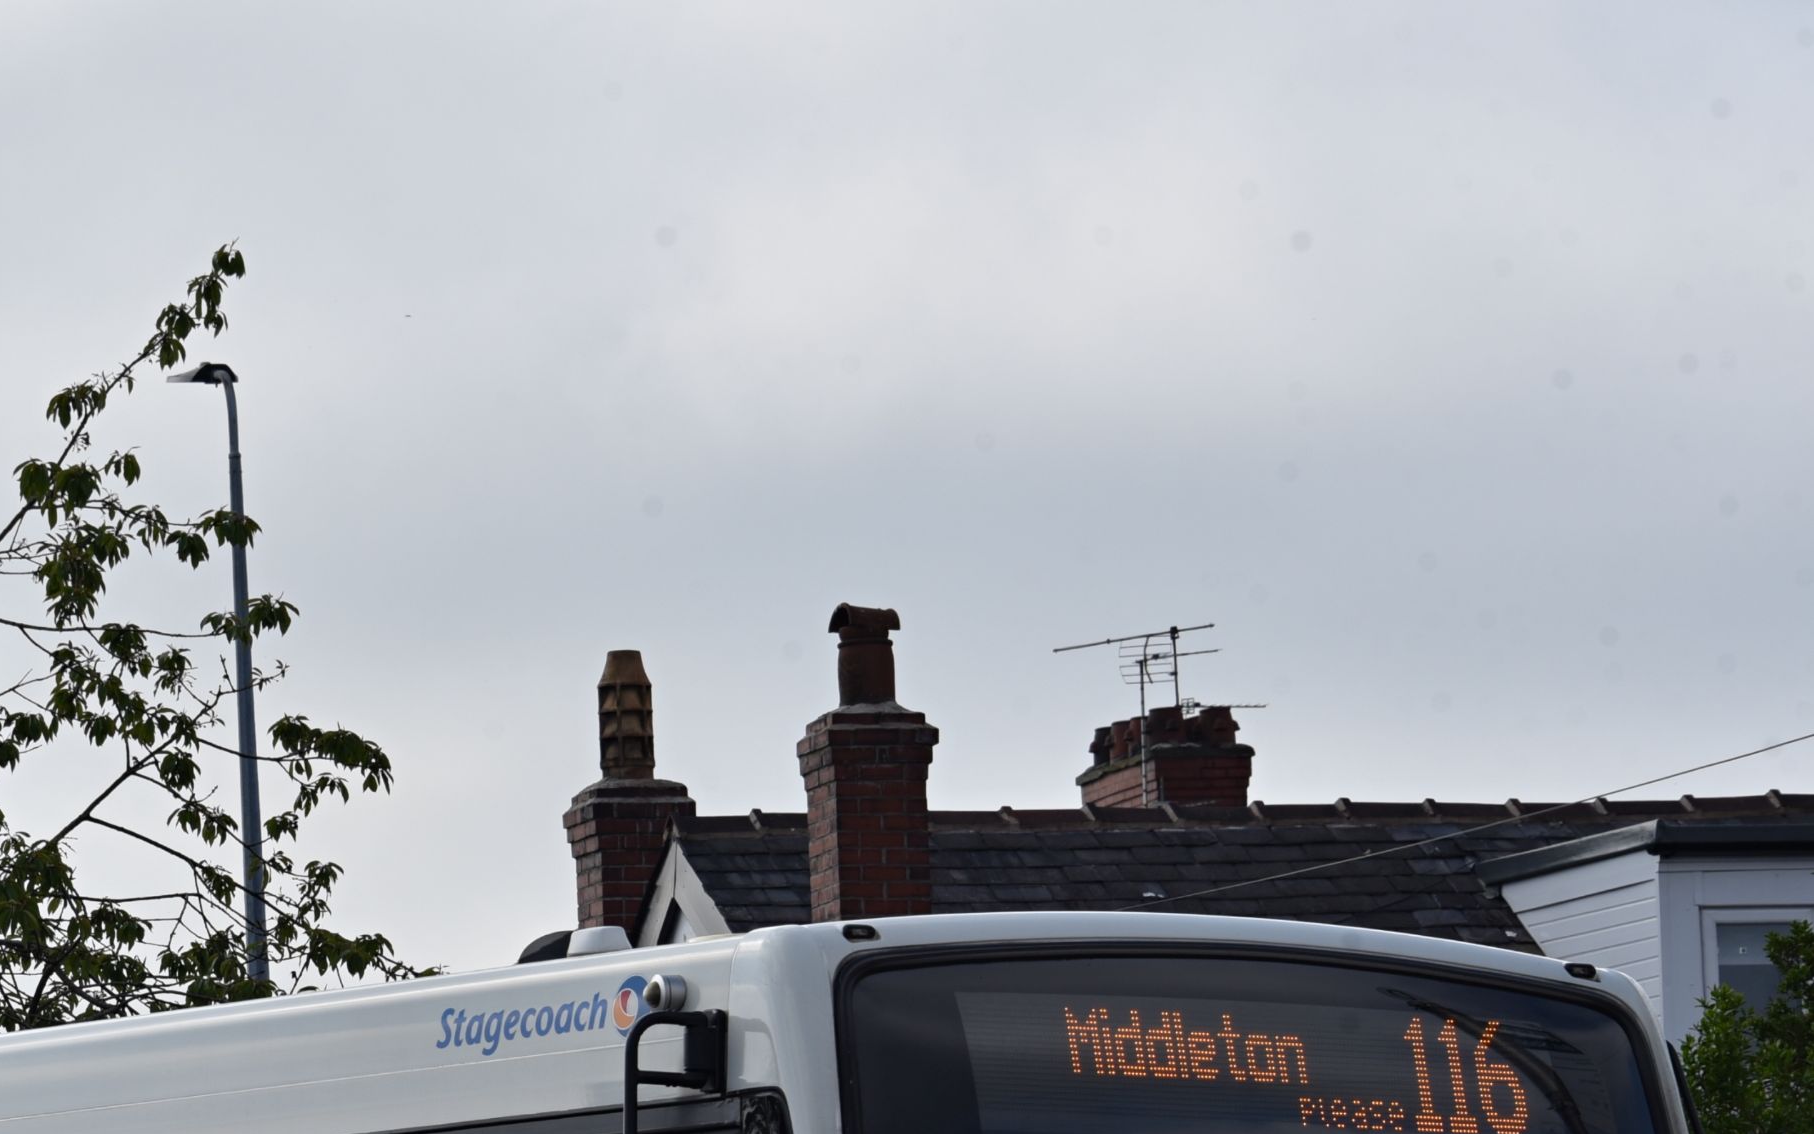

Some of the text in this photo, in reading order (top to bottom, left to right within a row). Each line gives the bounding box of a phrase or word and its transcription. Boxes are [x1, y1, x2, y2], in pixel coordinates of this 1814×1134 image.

[436, 992, 608, 1056] Stagecoach
[1064, 1006, 1309, 1085] Middleton
[1298, 1097, 1406, 1132] Please
